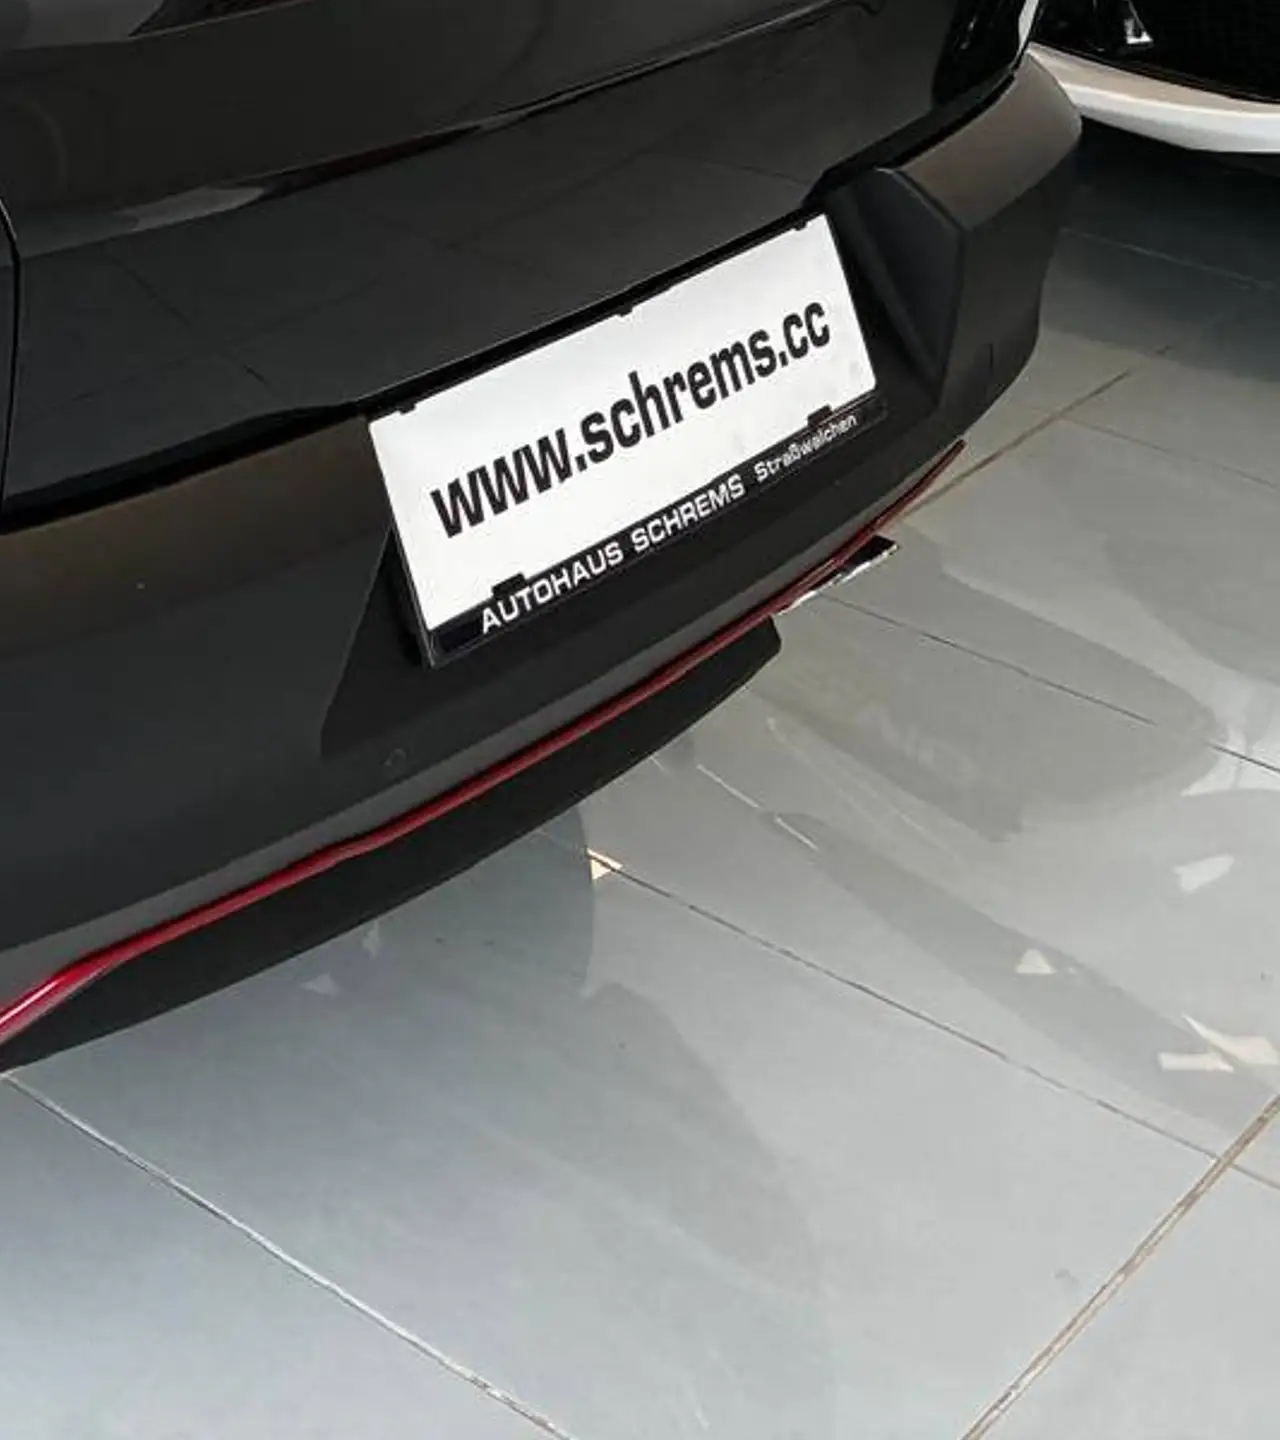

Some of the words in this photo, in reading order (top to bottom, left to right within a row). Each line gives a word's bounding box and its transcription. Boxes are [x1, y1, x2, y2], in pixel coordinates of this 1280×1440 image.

[429, 300, 832, 539] www.schrems.cc
[481, 540, 625, 635] AUTOHAUS
[630, 474, 746, 554] SCHREMS
[753, 413, 859, 482] Straßwalchen
